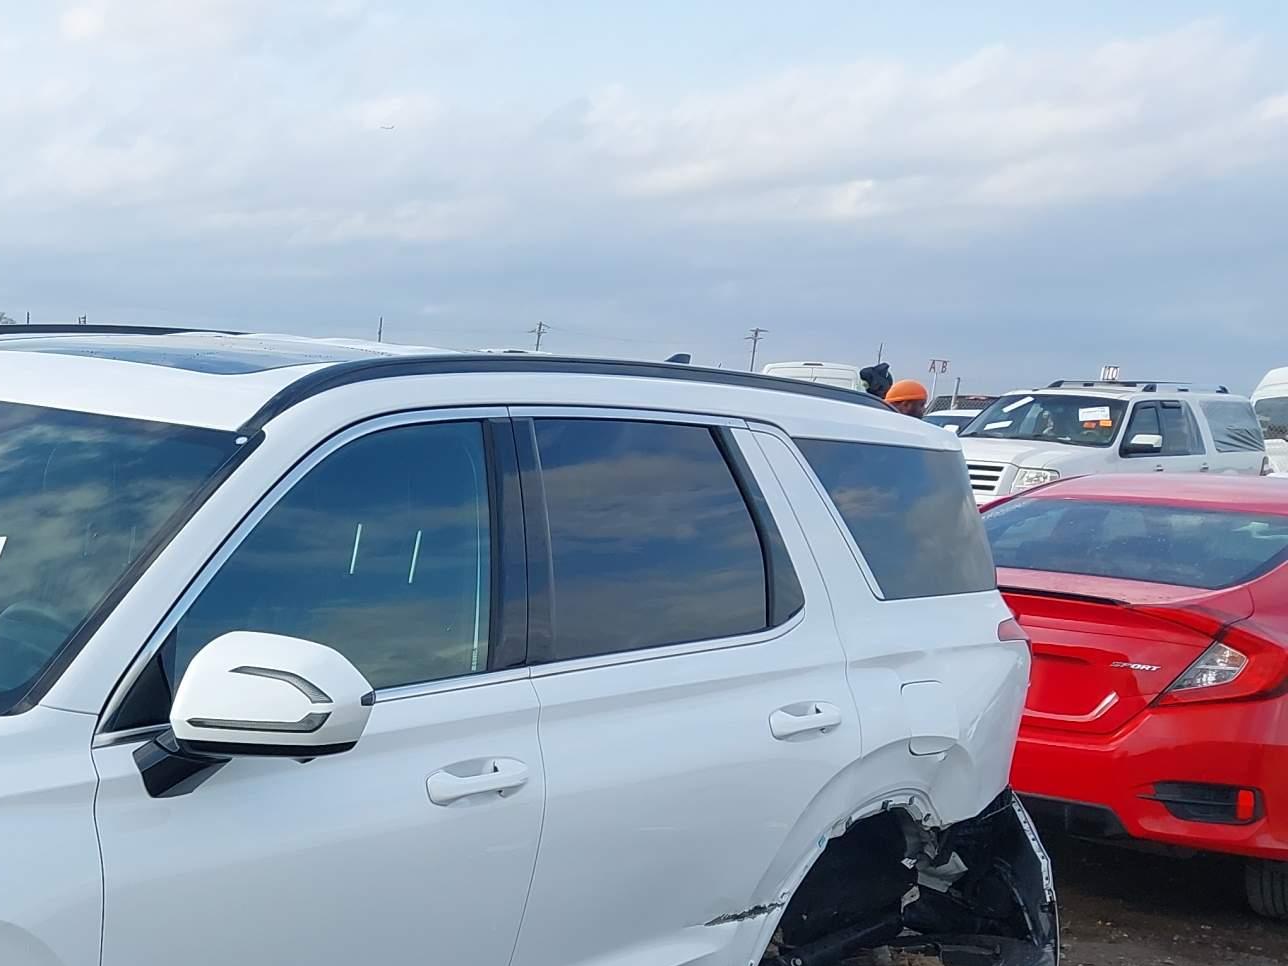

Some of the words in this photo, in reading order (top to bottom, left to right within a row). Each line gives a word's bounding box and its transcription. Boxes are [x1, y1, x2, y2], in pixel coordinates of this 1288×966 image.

[928, 359, 936, 373] A
[941, 360, 948, 373] B
[1111, 661, 1162, 671] SPORT
